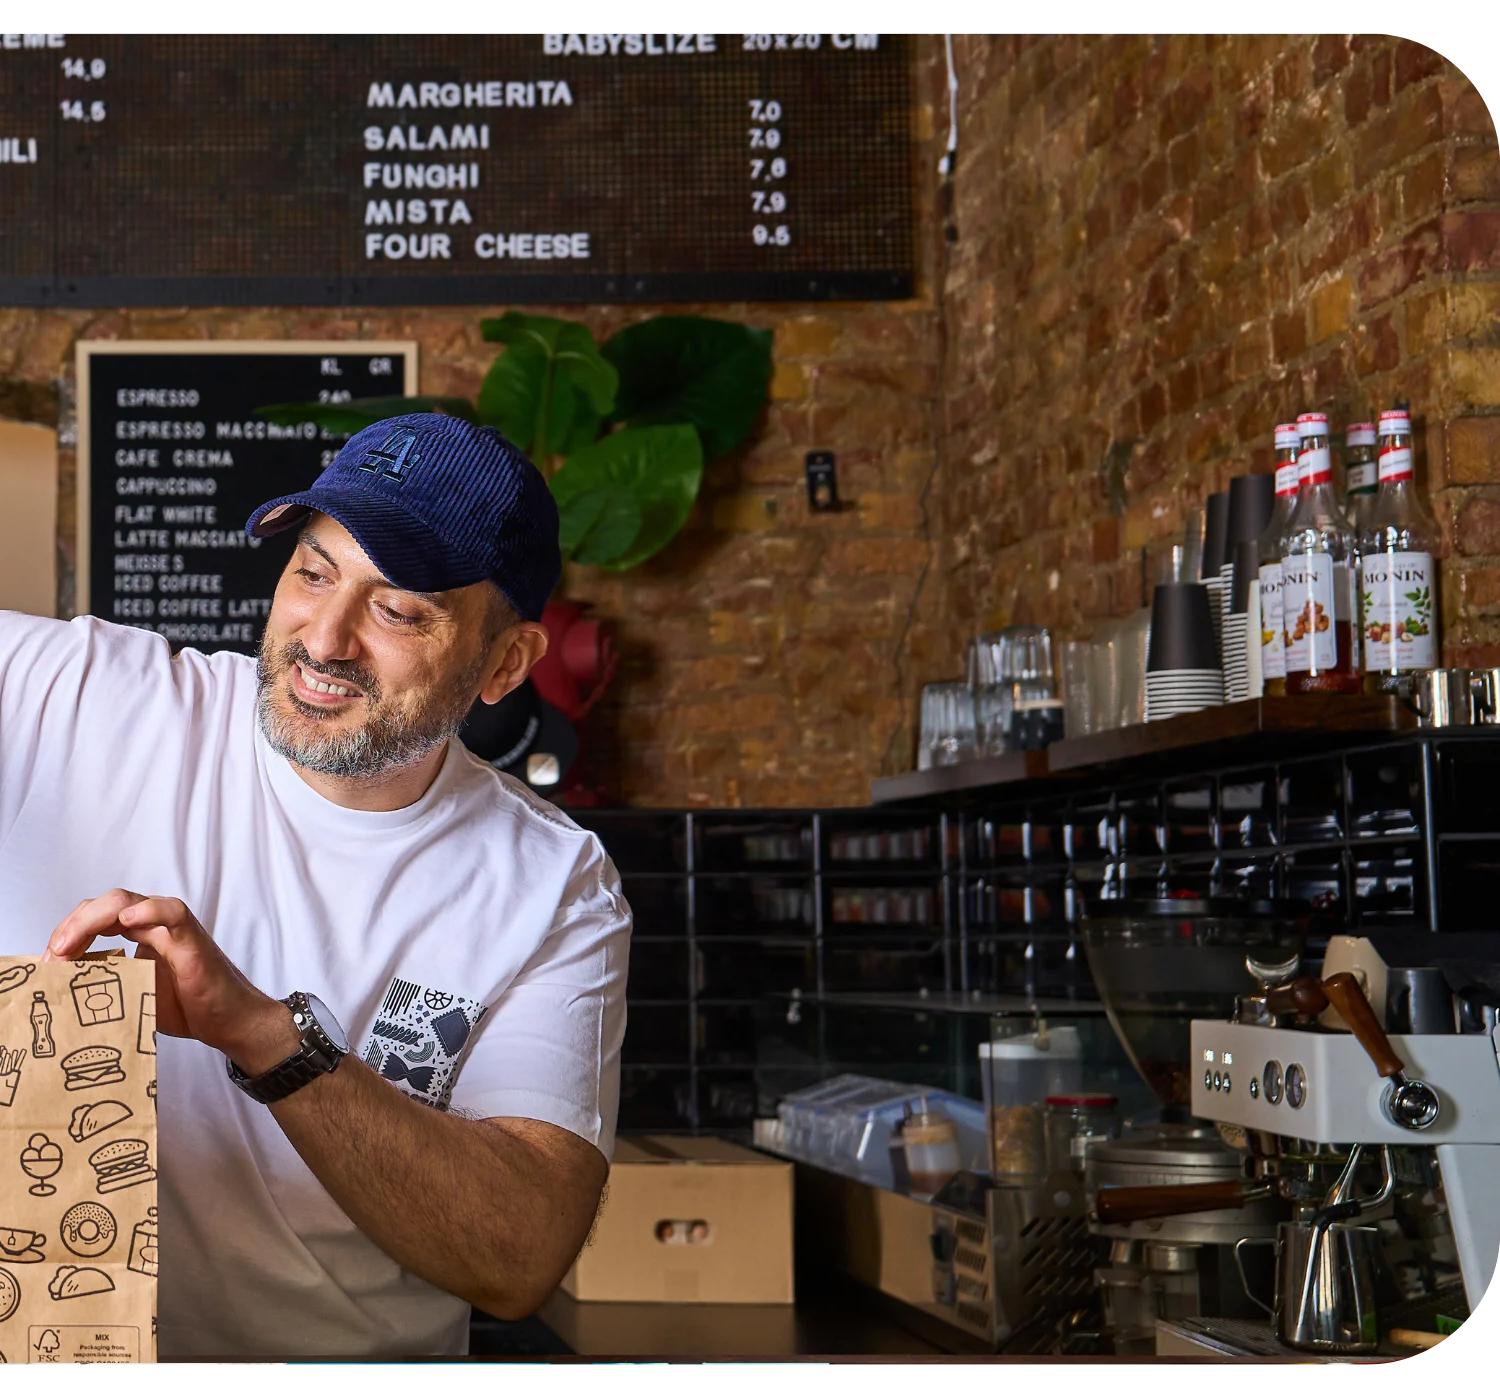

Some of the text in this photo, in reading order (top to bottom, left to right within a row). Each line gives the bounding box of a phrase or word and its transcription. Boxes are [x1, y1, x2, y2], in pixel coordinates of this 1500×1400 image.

[543, 32, 717, 56] BABYSLIZE
[831, 32, 879, 50] CM
[366, 80, 573, 108] MARGHERITA
[363, 123, 490, 151] SALAMI
[363, 162, 479, 190] FUNGHI
[364, 198, 472, 226] MISTA
[365, 232, 451, 260] FOUR
[474, 232, 590, 260] CHEESE
[117, 388, 200, 407] ESPRESSO
[116, 420, 205, 439] ESPRESSO
[115, 448, 234, 468] CAFE CREMA
[116, 477, 217, 496] CAPPUCCINO
[115, 505, 217, 524] FLAT WHITE
[115, 529, 169, 548] LATTE
[114, 574, 222, 593] ICED COFFEE
[113, 598, 271, 617] ICED COFFEE LATT
[157, 622, 253, 642] CHOCOLATE
[38, 1354, 61, 1363] FSC
